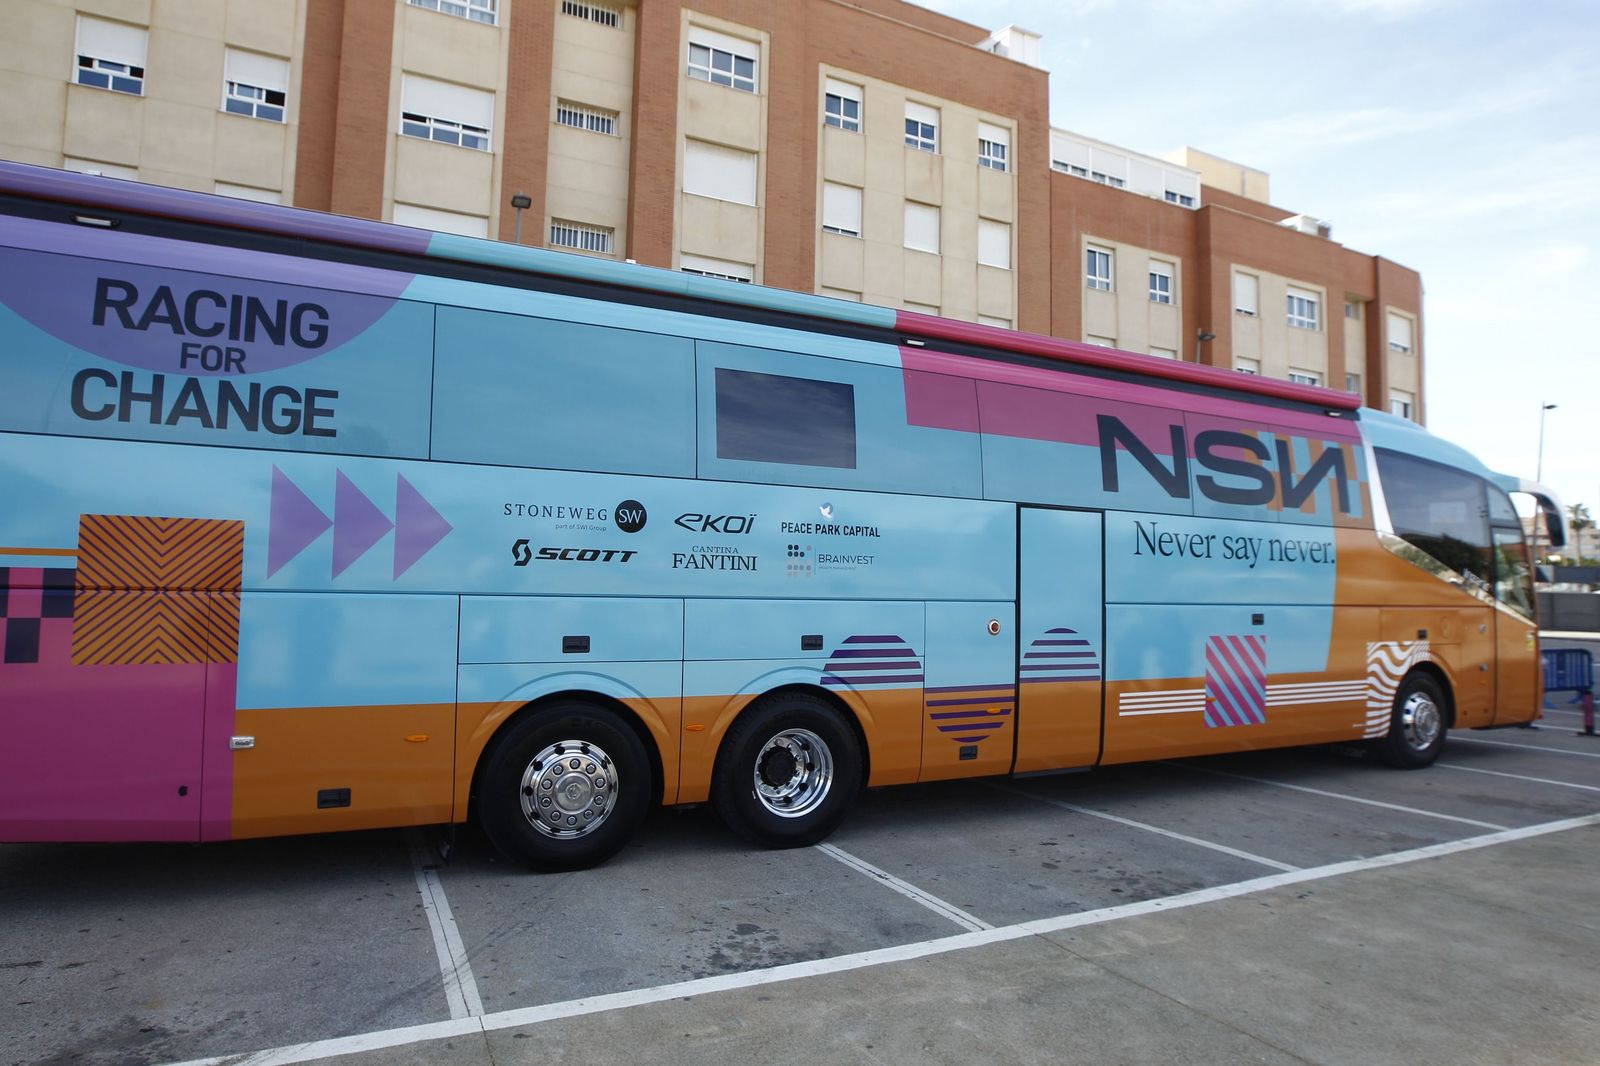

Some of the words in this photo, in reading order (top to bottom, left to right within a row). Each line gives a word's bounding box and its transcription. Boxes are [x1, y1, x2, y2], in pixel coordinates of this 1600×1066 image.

[92, 277, 329, 349] RACING
[179, 342, 246, 374] FOR
[70, 367, 339, 438] CHANGE
[503, 503, 608, 520] STONEWEG
[618, 508, 643, 524] SW
[781, 522, 812, 534] PEACE
[815, 524, 840, 535] PARK
[843, 525, 881, 537] CAPITAL
[691, 545, 739, 554] CANTINA
[1134, 520, 1215, 558] Never
[1222, 534, 1262, 568] say
[1268, 538, 1336, 564] never.
[535, 548, 638, 563] SCOTT
[672, 553, 758, 571] FANTINI
[818, 554, 875, 564] BRAINVEST
